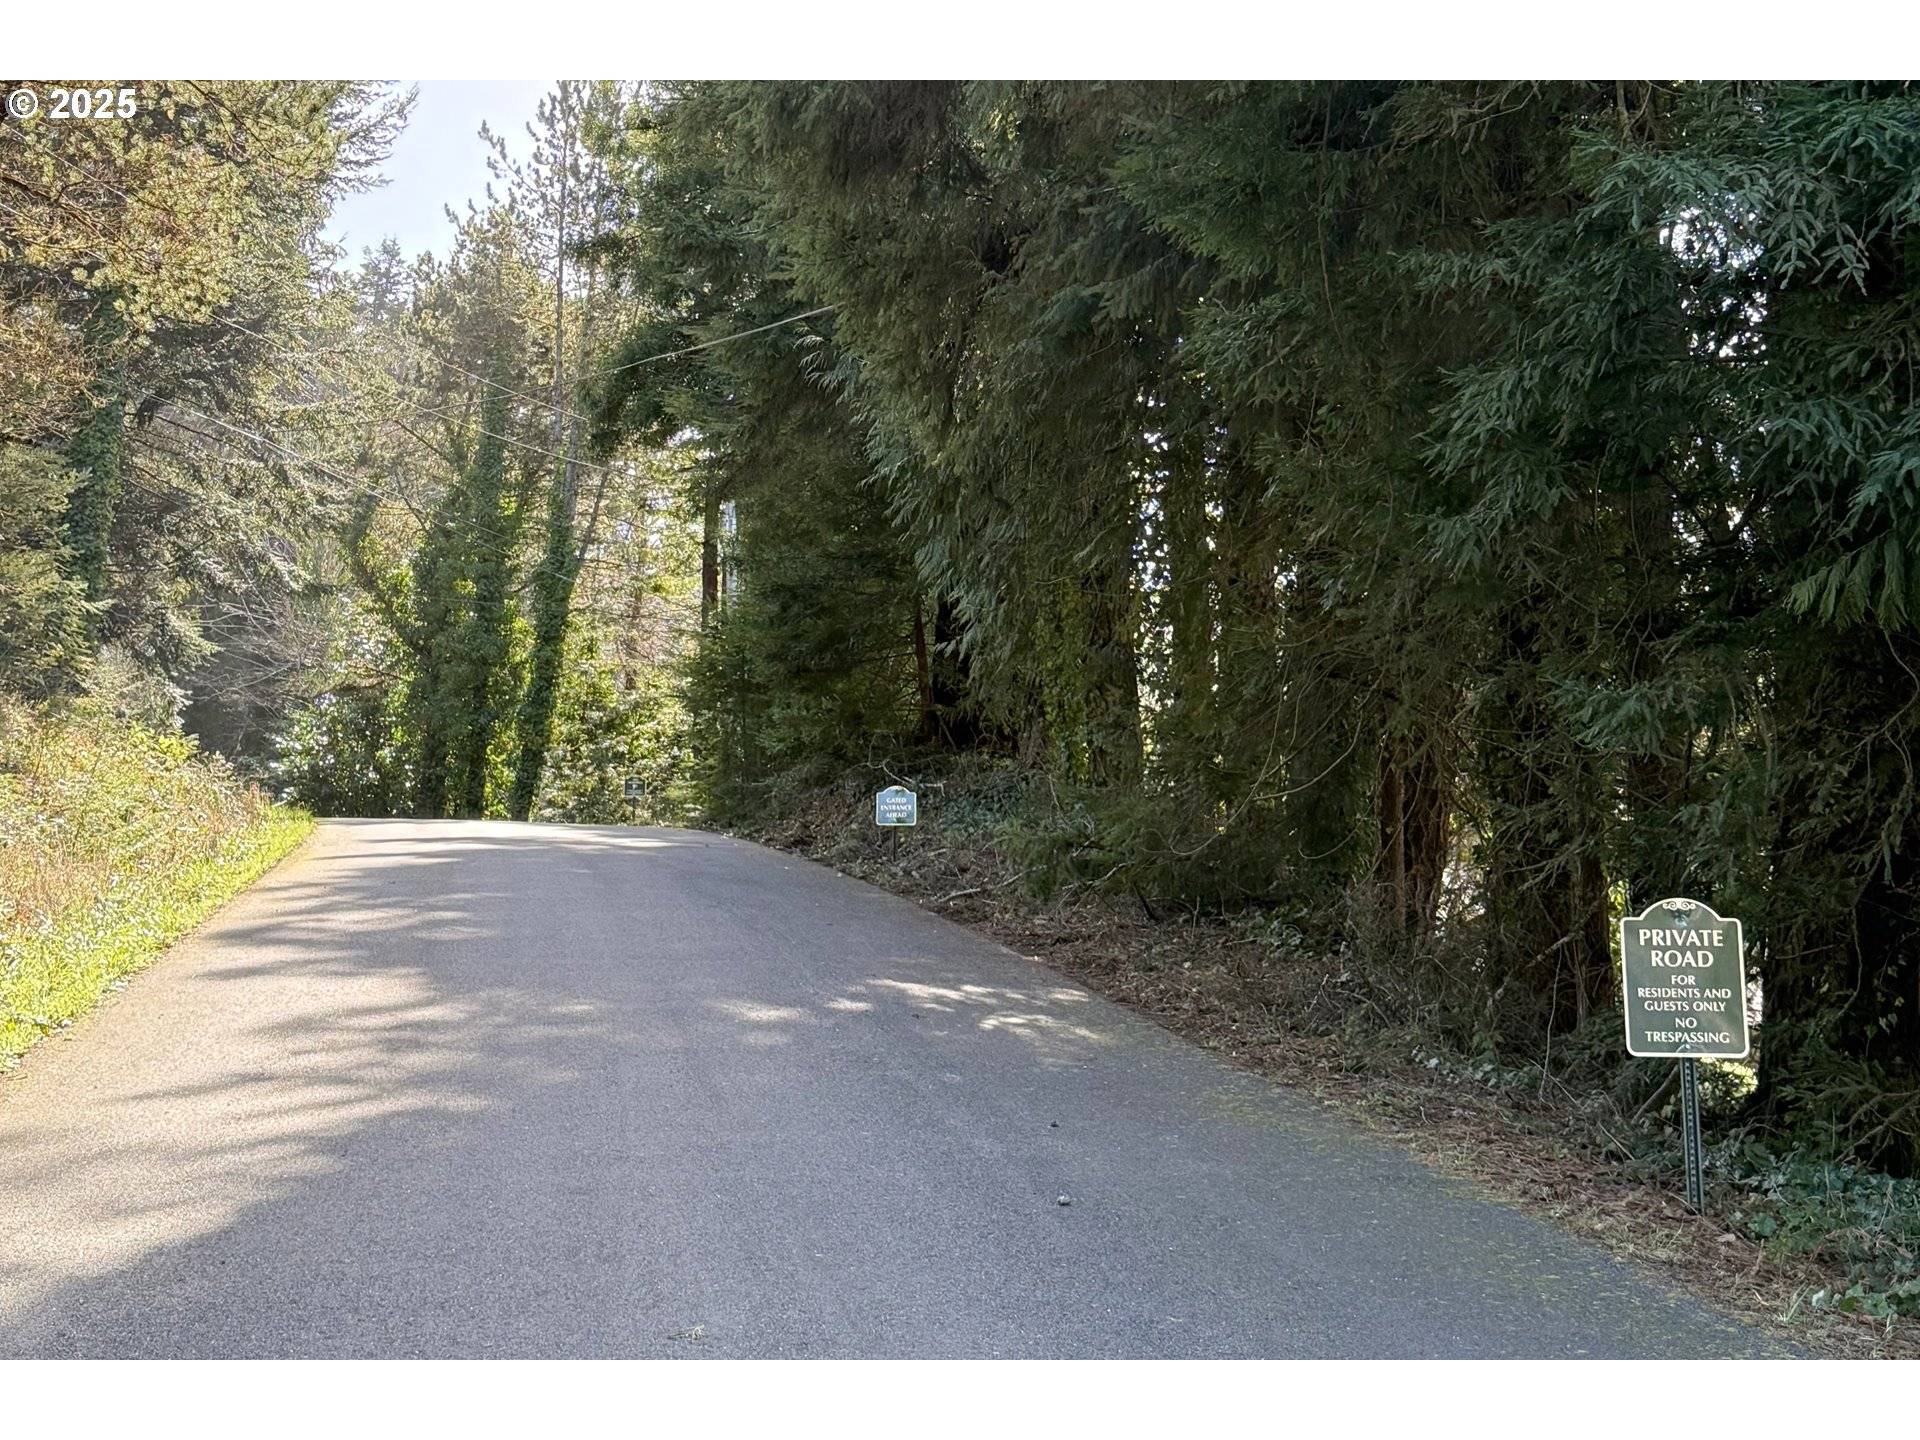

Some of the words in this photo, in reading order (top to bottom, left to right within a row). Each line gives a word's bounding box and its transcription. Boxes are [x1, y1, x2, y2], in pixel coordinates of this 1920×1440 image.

[1638, 928, 1724, 947] PRIVATE
[1651, 950, 1714, 968] ROAD
[1671, 974, 1696, 985] FOR
[1637, 987, 1700, 999] RESIDENTS
[1703, 988, 1732, 999] AND
[1644, 1000, 1690, 1012] GUESTS
[1693, 1001, 1726, 1012] ONLY
[1675, 1017, 1698, 1029] NO
[1644, 1031, 1731, 1043] TRESPASSING
